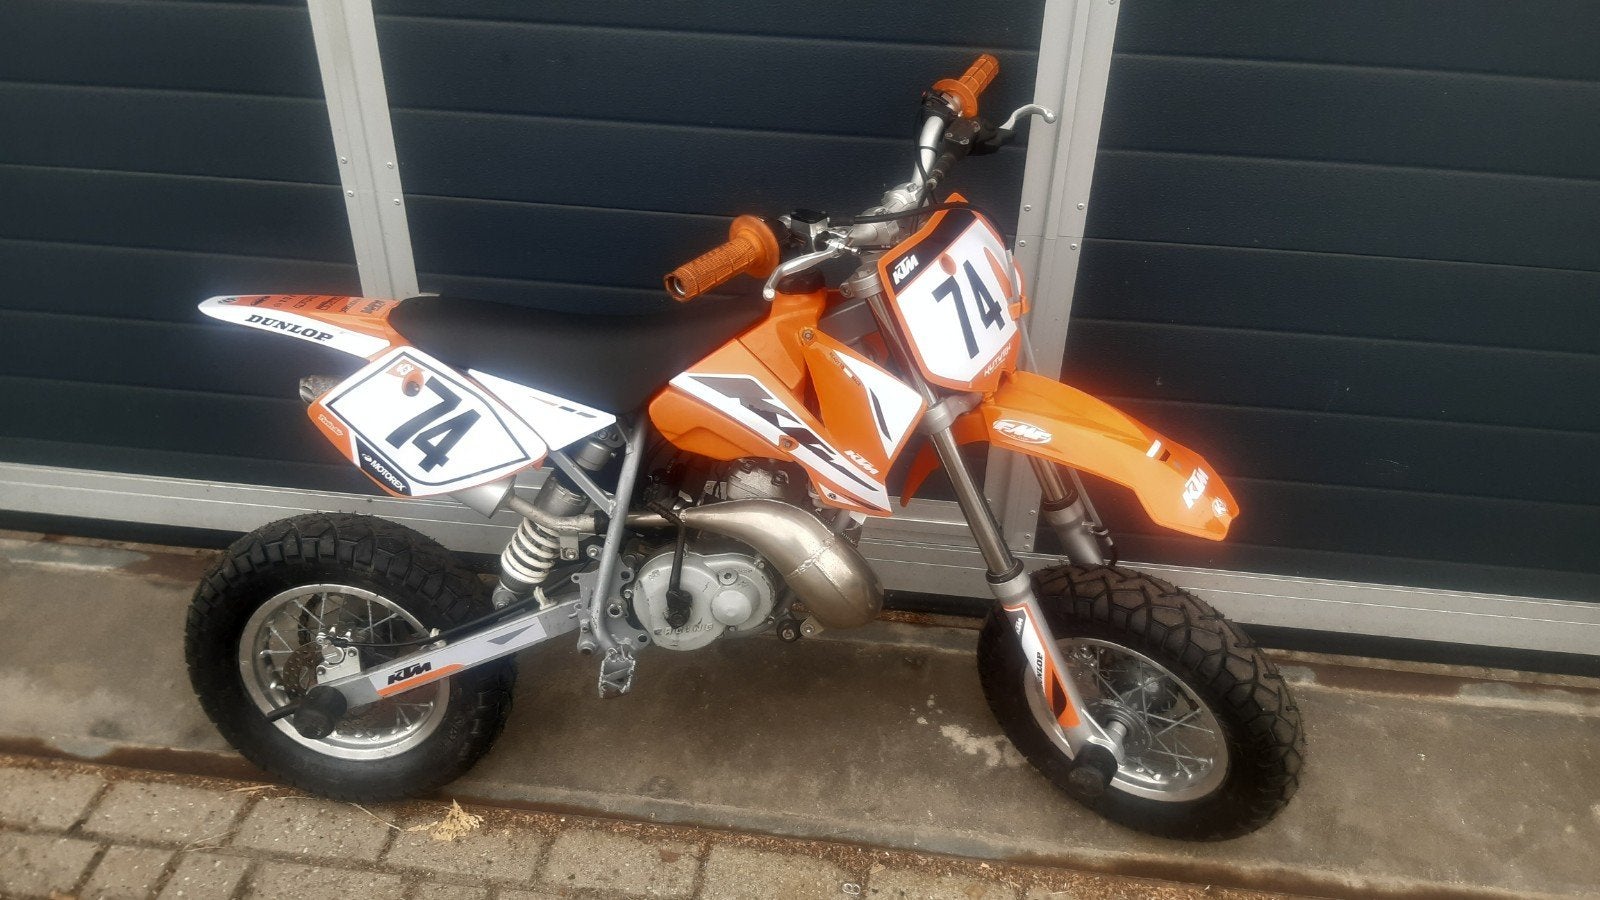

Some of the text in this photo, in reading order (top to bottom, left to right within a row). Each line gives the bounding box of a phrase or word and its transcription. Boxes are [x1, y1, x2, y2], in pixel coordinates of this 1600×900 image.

[892, 254, 919, 285] KTM
[931, 259, 1006, 360] 74
[245, 314, 334, 342] DUNLOP
[385, 376, 482, 473] 74
[370, 460, 406, 492] MOTOREX
[844, 450, 879, 475] KTM
[1182, 466, 1209, 510] KTM
[387, 661, 432, 685] KTM
